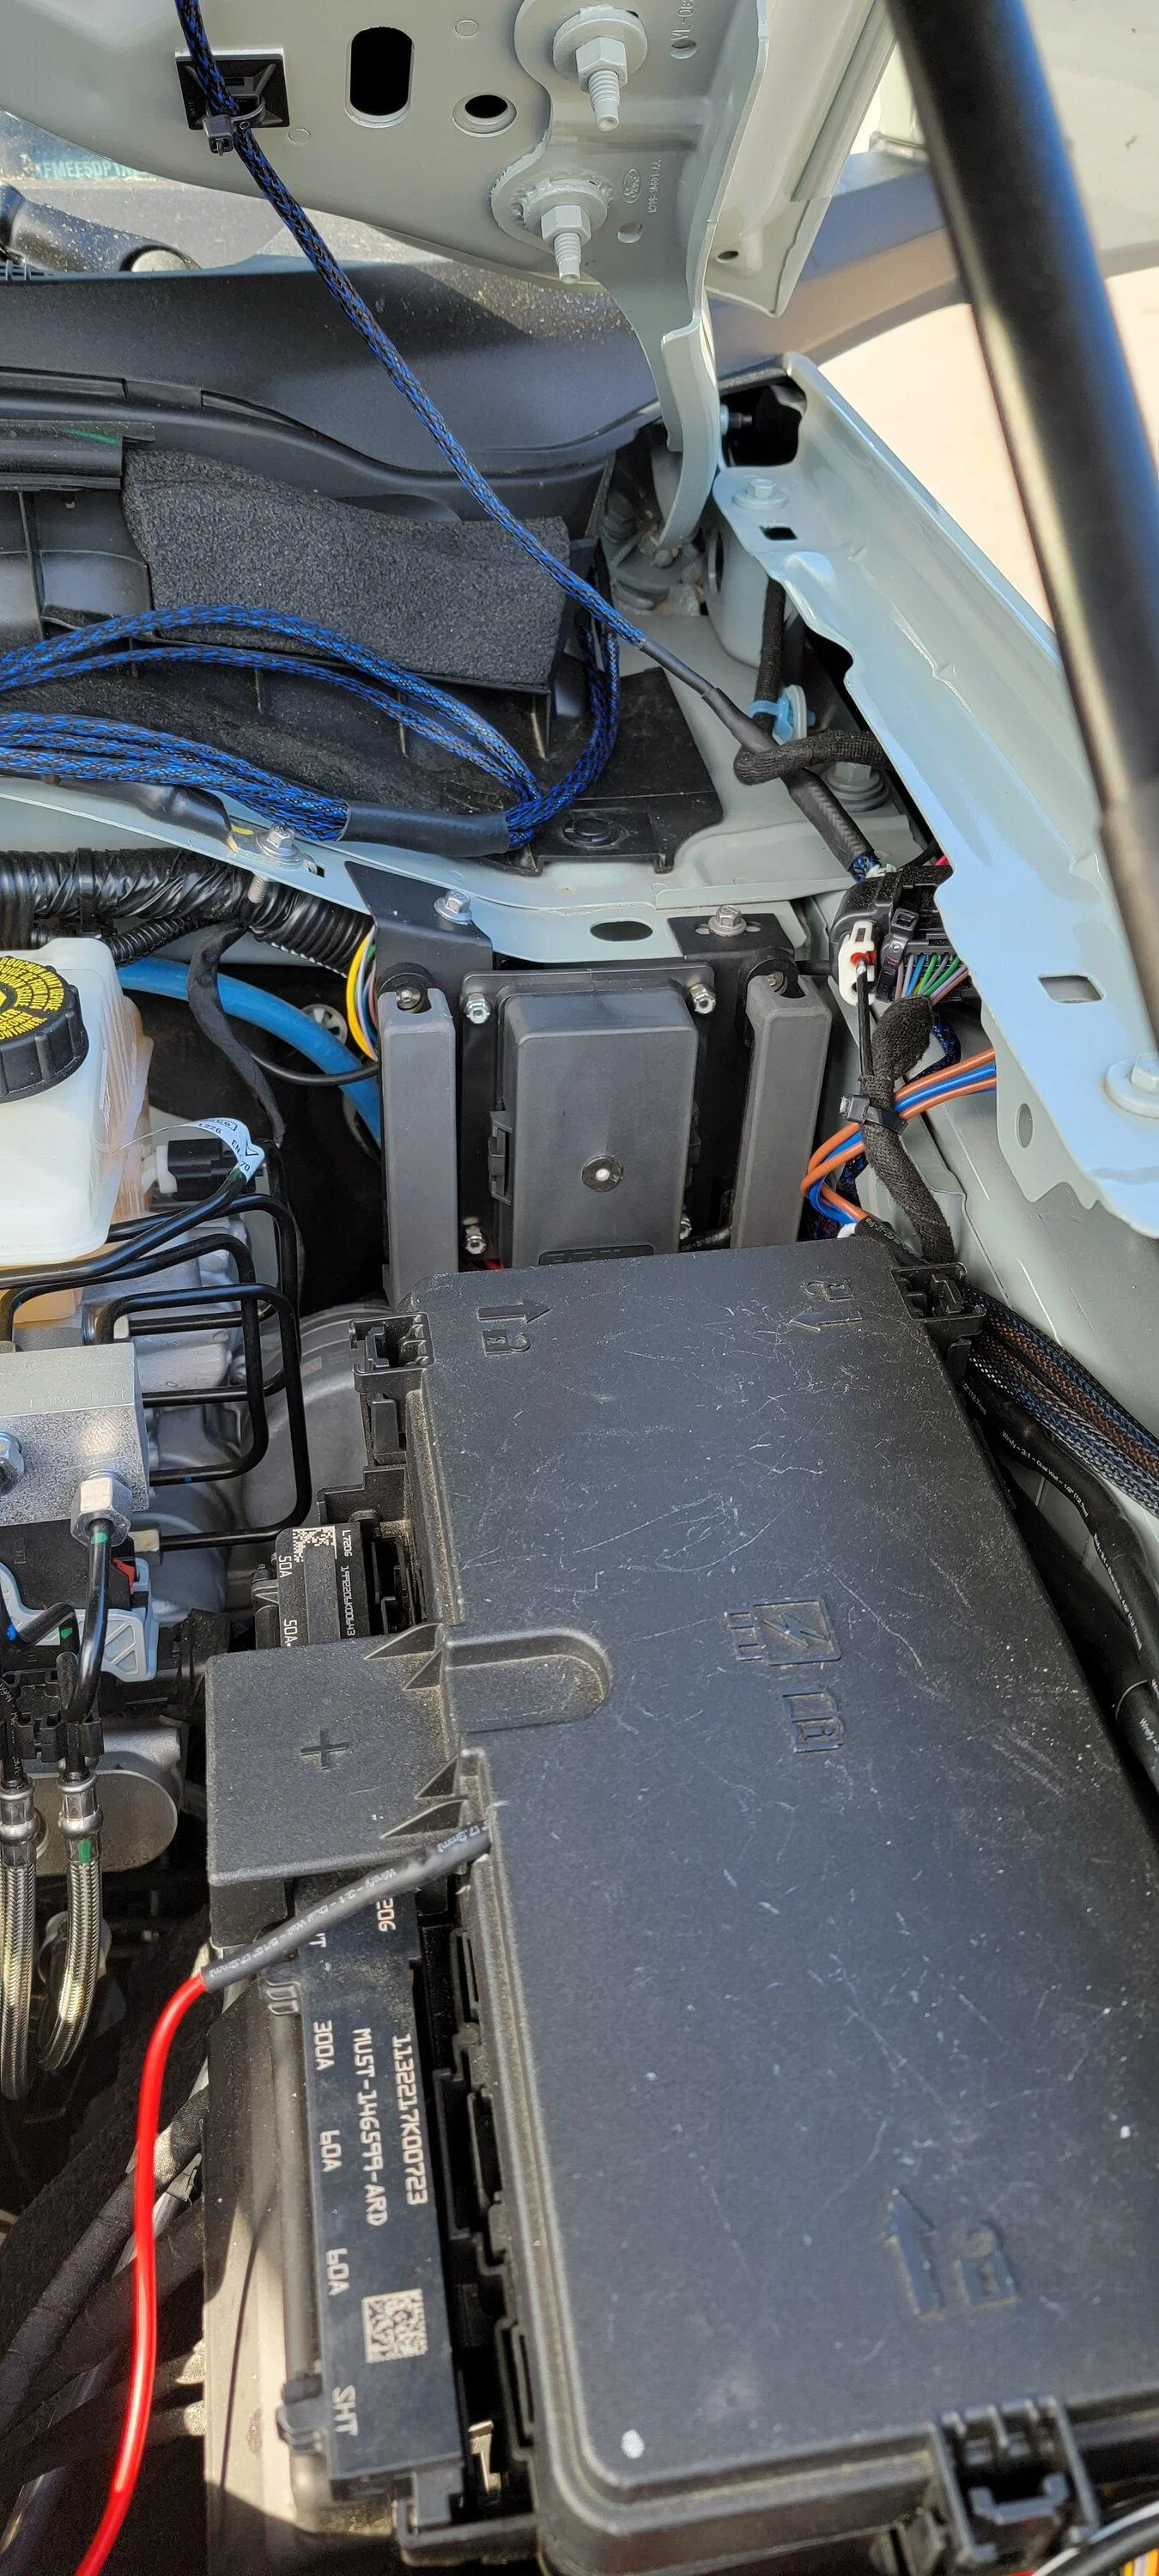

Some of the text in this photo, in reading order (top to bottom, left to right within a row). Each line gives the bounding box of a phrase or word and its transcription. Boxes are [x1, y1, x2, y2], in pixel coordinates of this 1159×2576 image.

[279, 1555, 293, 1578] 50A
[392, 2033, 428, 2206] 1132217K00723
[313, 2020, 359, 2436] 300A 60A 60A SHT
